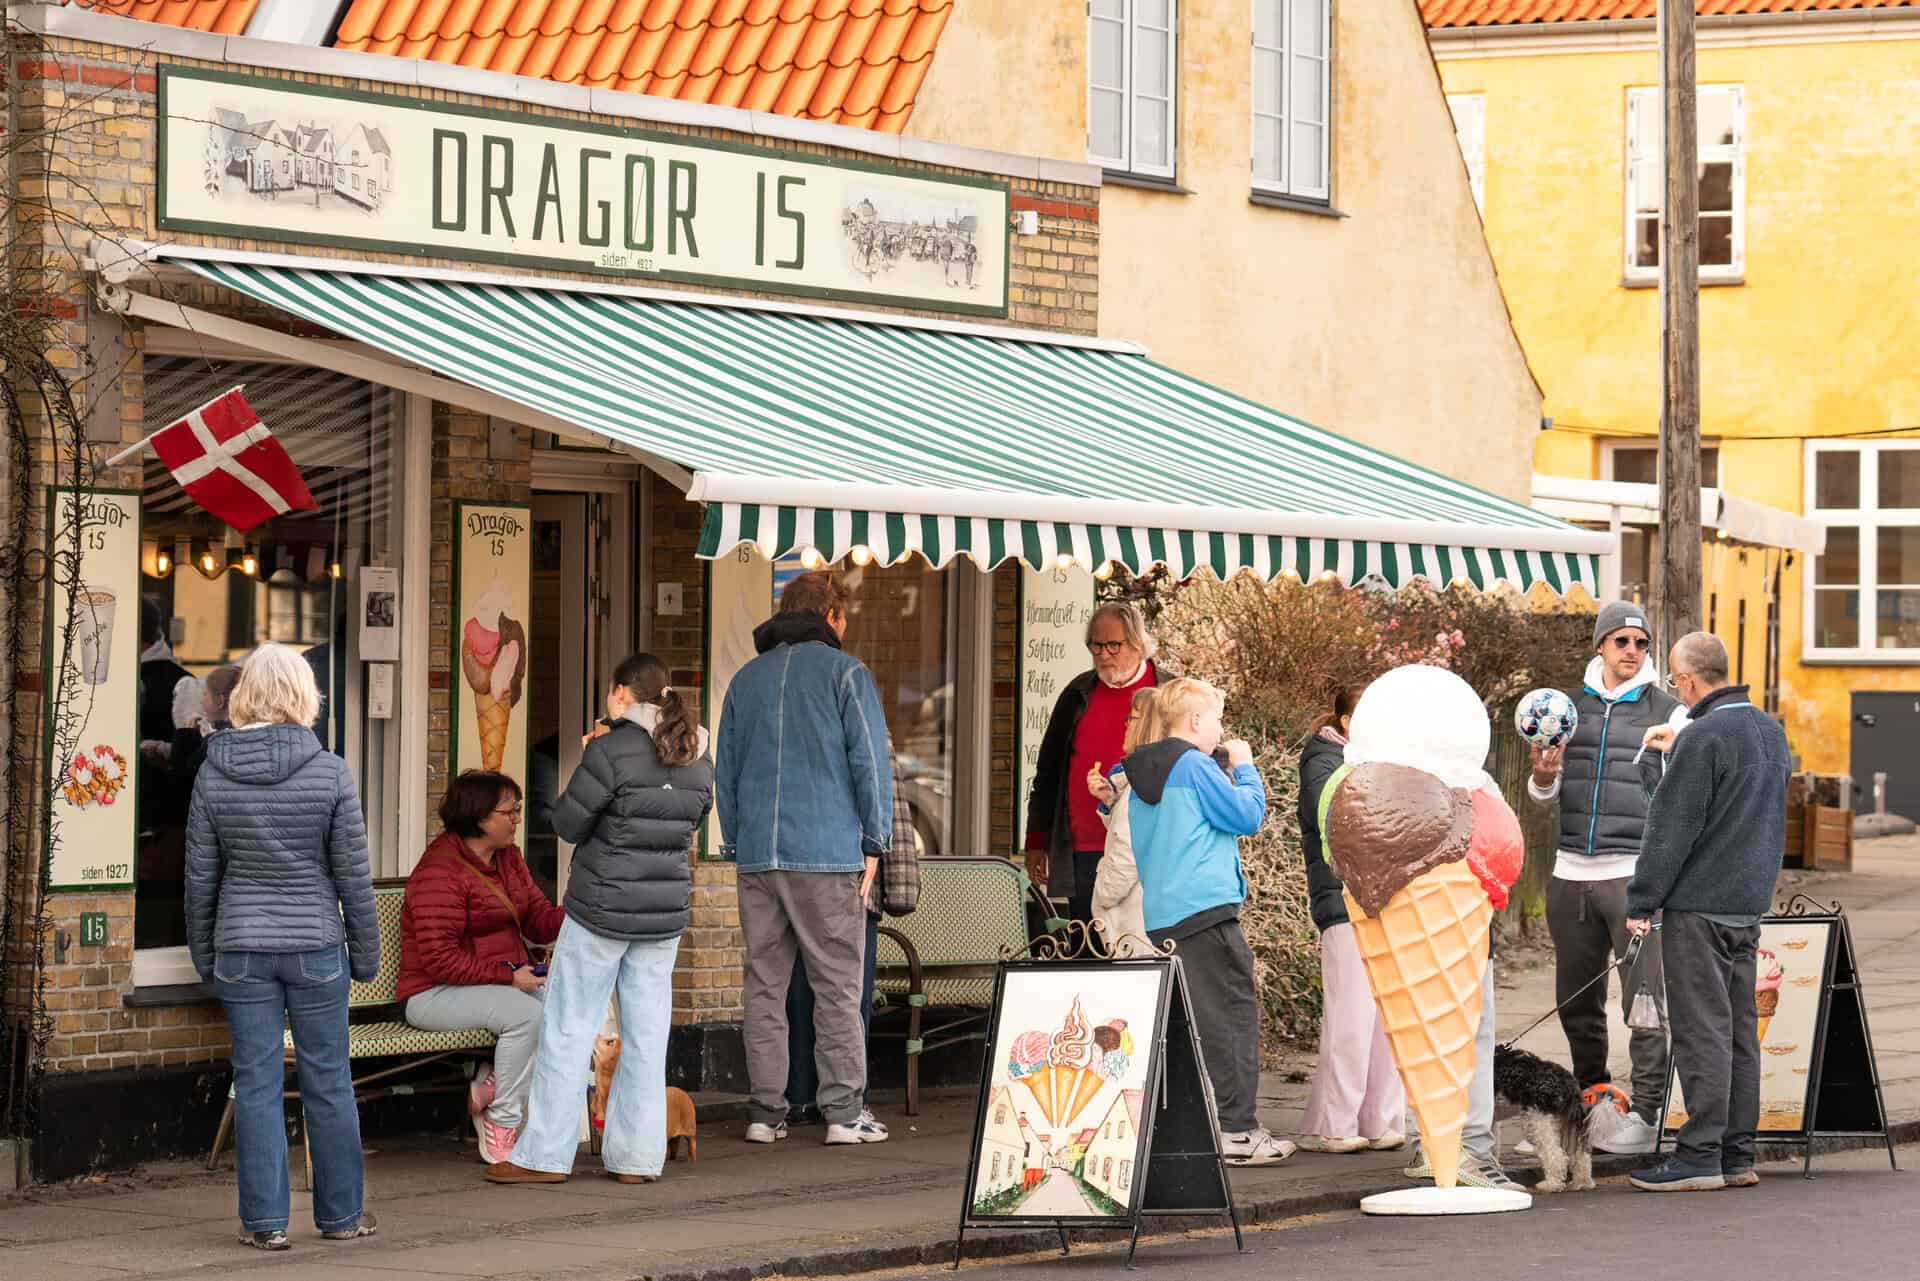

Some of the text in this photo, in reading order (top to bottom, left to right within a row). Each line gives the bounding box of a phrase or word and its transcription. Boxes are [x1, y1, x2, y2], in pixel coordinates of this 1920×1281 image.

[433, 128, 806, 270] DRAGØR IS
[601, 251, 627, 267] siden
[1025, 670, 1056, 698] Kaffe
[81, 863, 129, 880] siden 1927
[87, 917, 104, 941] 15
